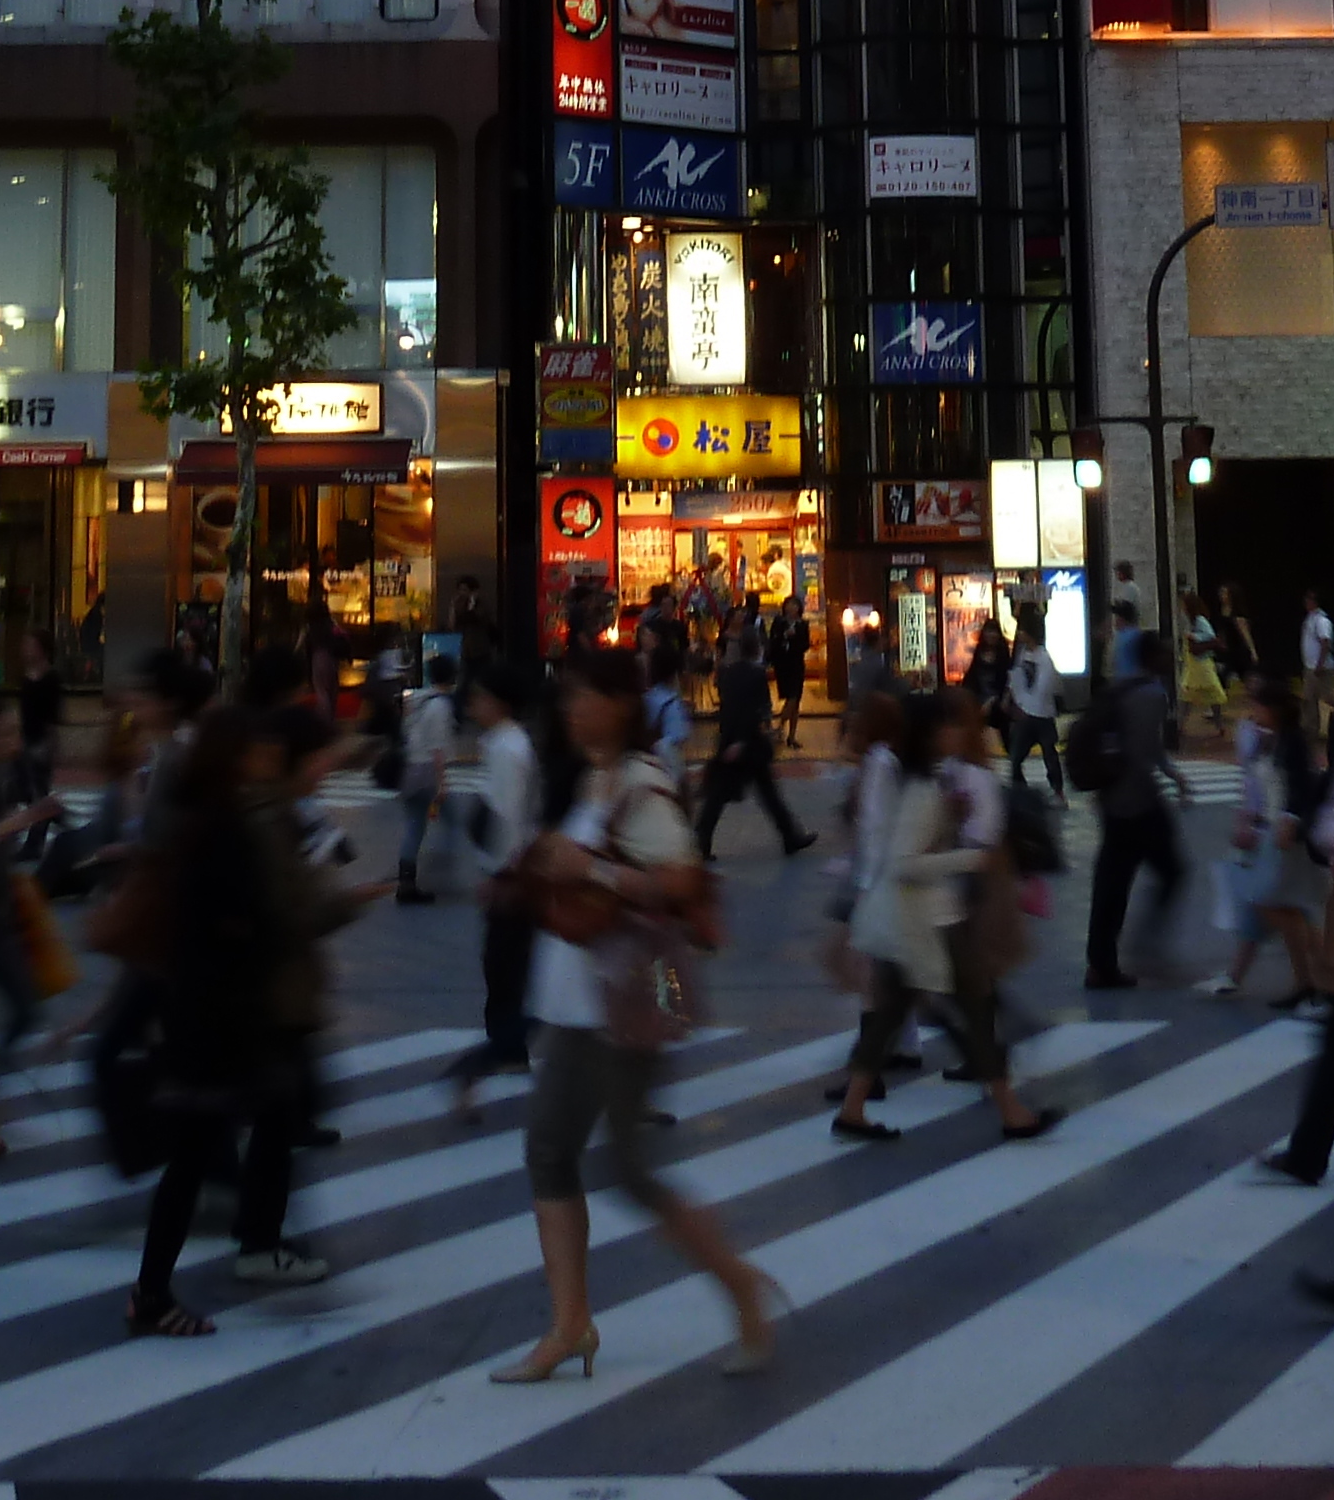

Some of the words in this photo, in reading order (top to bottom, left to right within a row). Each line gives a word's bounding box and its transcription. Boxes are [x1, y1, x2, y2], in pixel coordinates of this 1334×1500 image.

[564, 140, 611, 188] 5F
[680, 193, 727, 211] CROSS
[1221, 188, 1315, 210] 神南一丁目
[692, 420, 772, 455] 松屋
